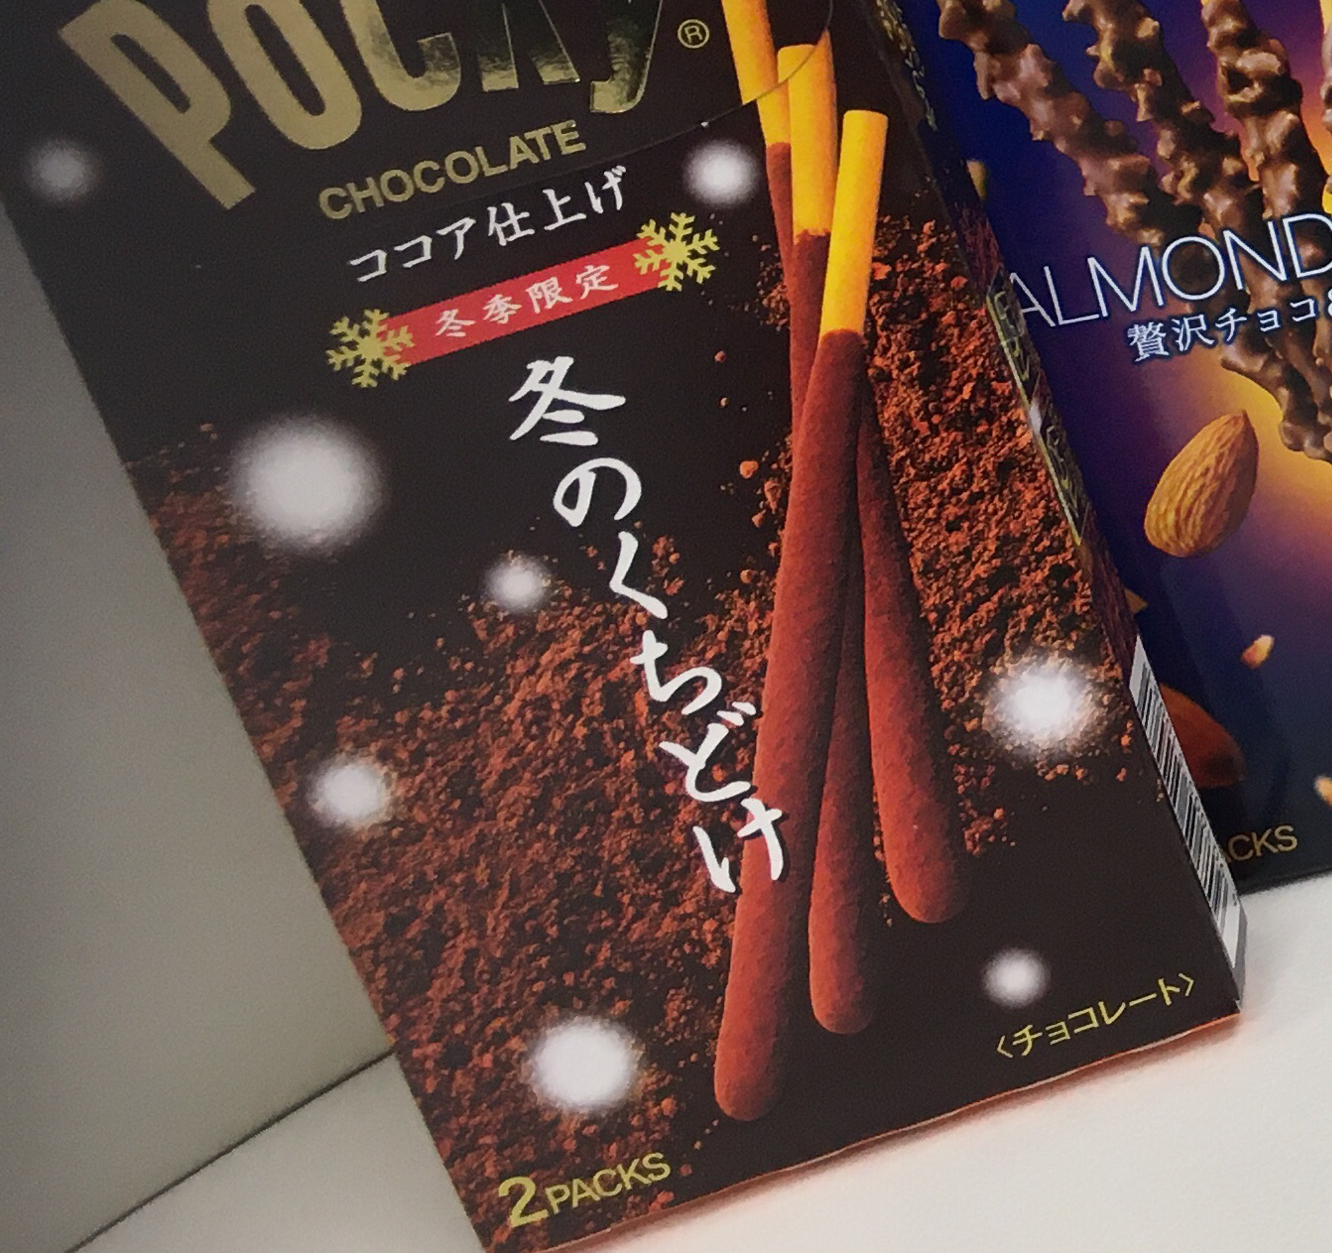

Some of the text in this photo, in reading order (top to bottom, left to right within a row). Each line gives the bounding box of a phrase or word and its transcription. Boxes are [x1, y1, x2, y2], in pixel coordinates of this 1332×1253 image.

[319, 119, 587, 221] CHOCOLATE
[349, 165, 627, 283] ココア仕上げ
[434, 263, 619, 339] 冬季限定
[509, 356, 789, 894] 冬のくちどけ
[1219, 825, 1298, 863] CKS
